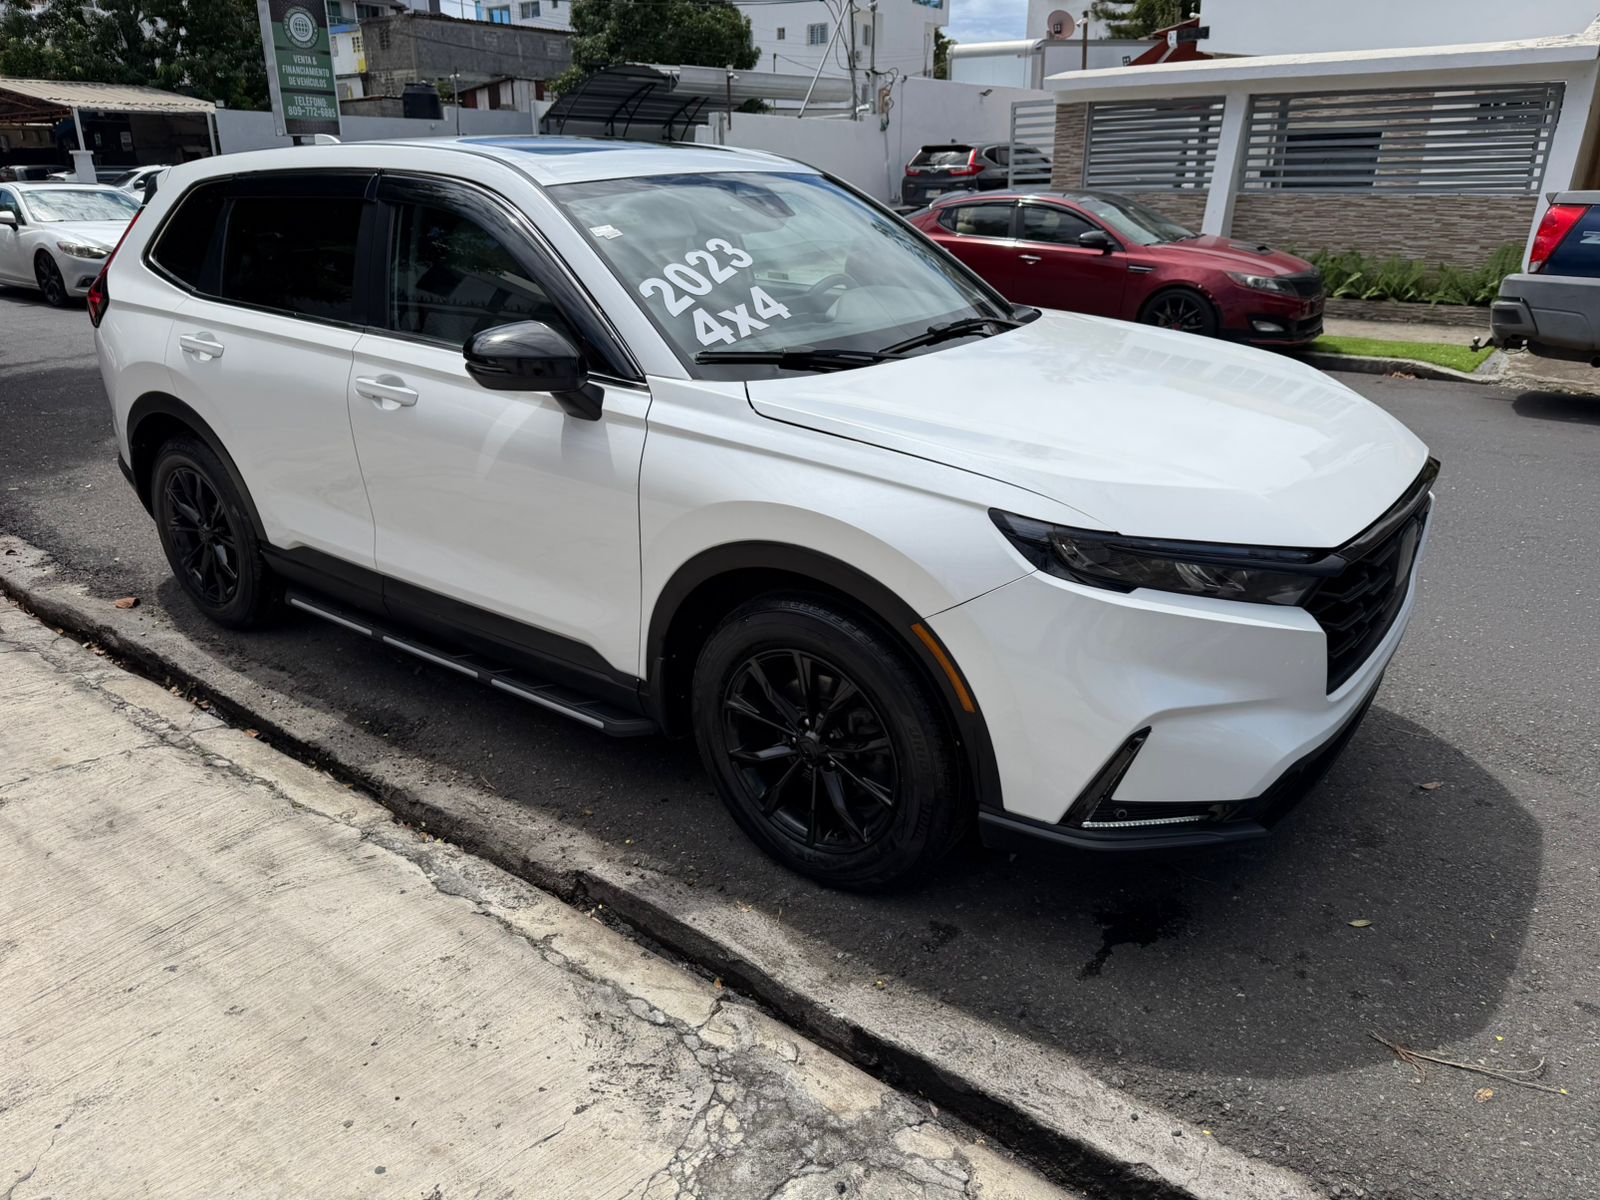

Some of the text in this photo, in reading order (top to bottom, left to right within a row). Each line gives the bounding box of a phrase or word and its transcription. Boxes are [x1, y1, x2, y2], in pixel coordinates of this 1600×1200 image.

[293, 55, 312, 64] VENTA
[282, 65, 329, 77] FINANCIAMIENTO
[288, 77, 296, 85] DE
[639, 238, 753, 317] 2023
[692, 286, 792, 346] 4x4
